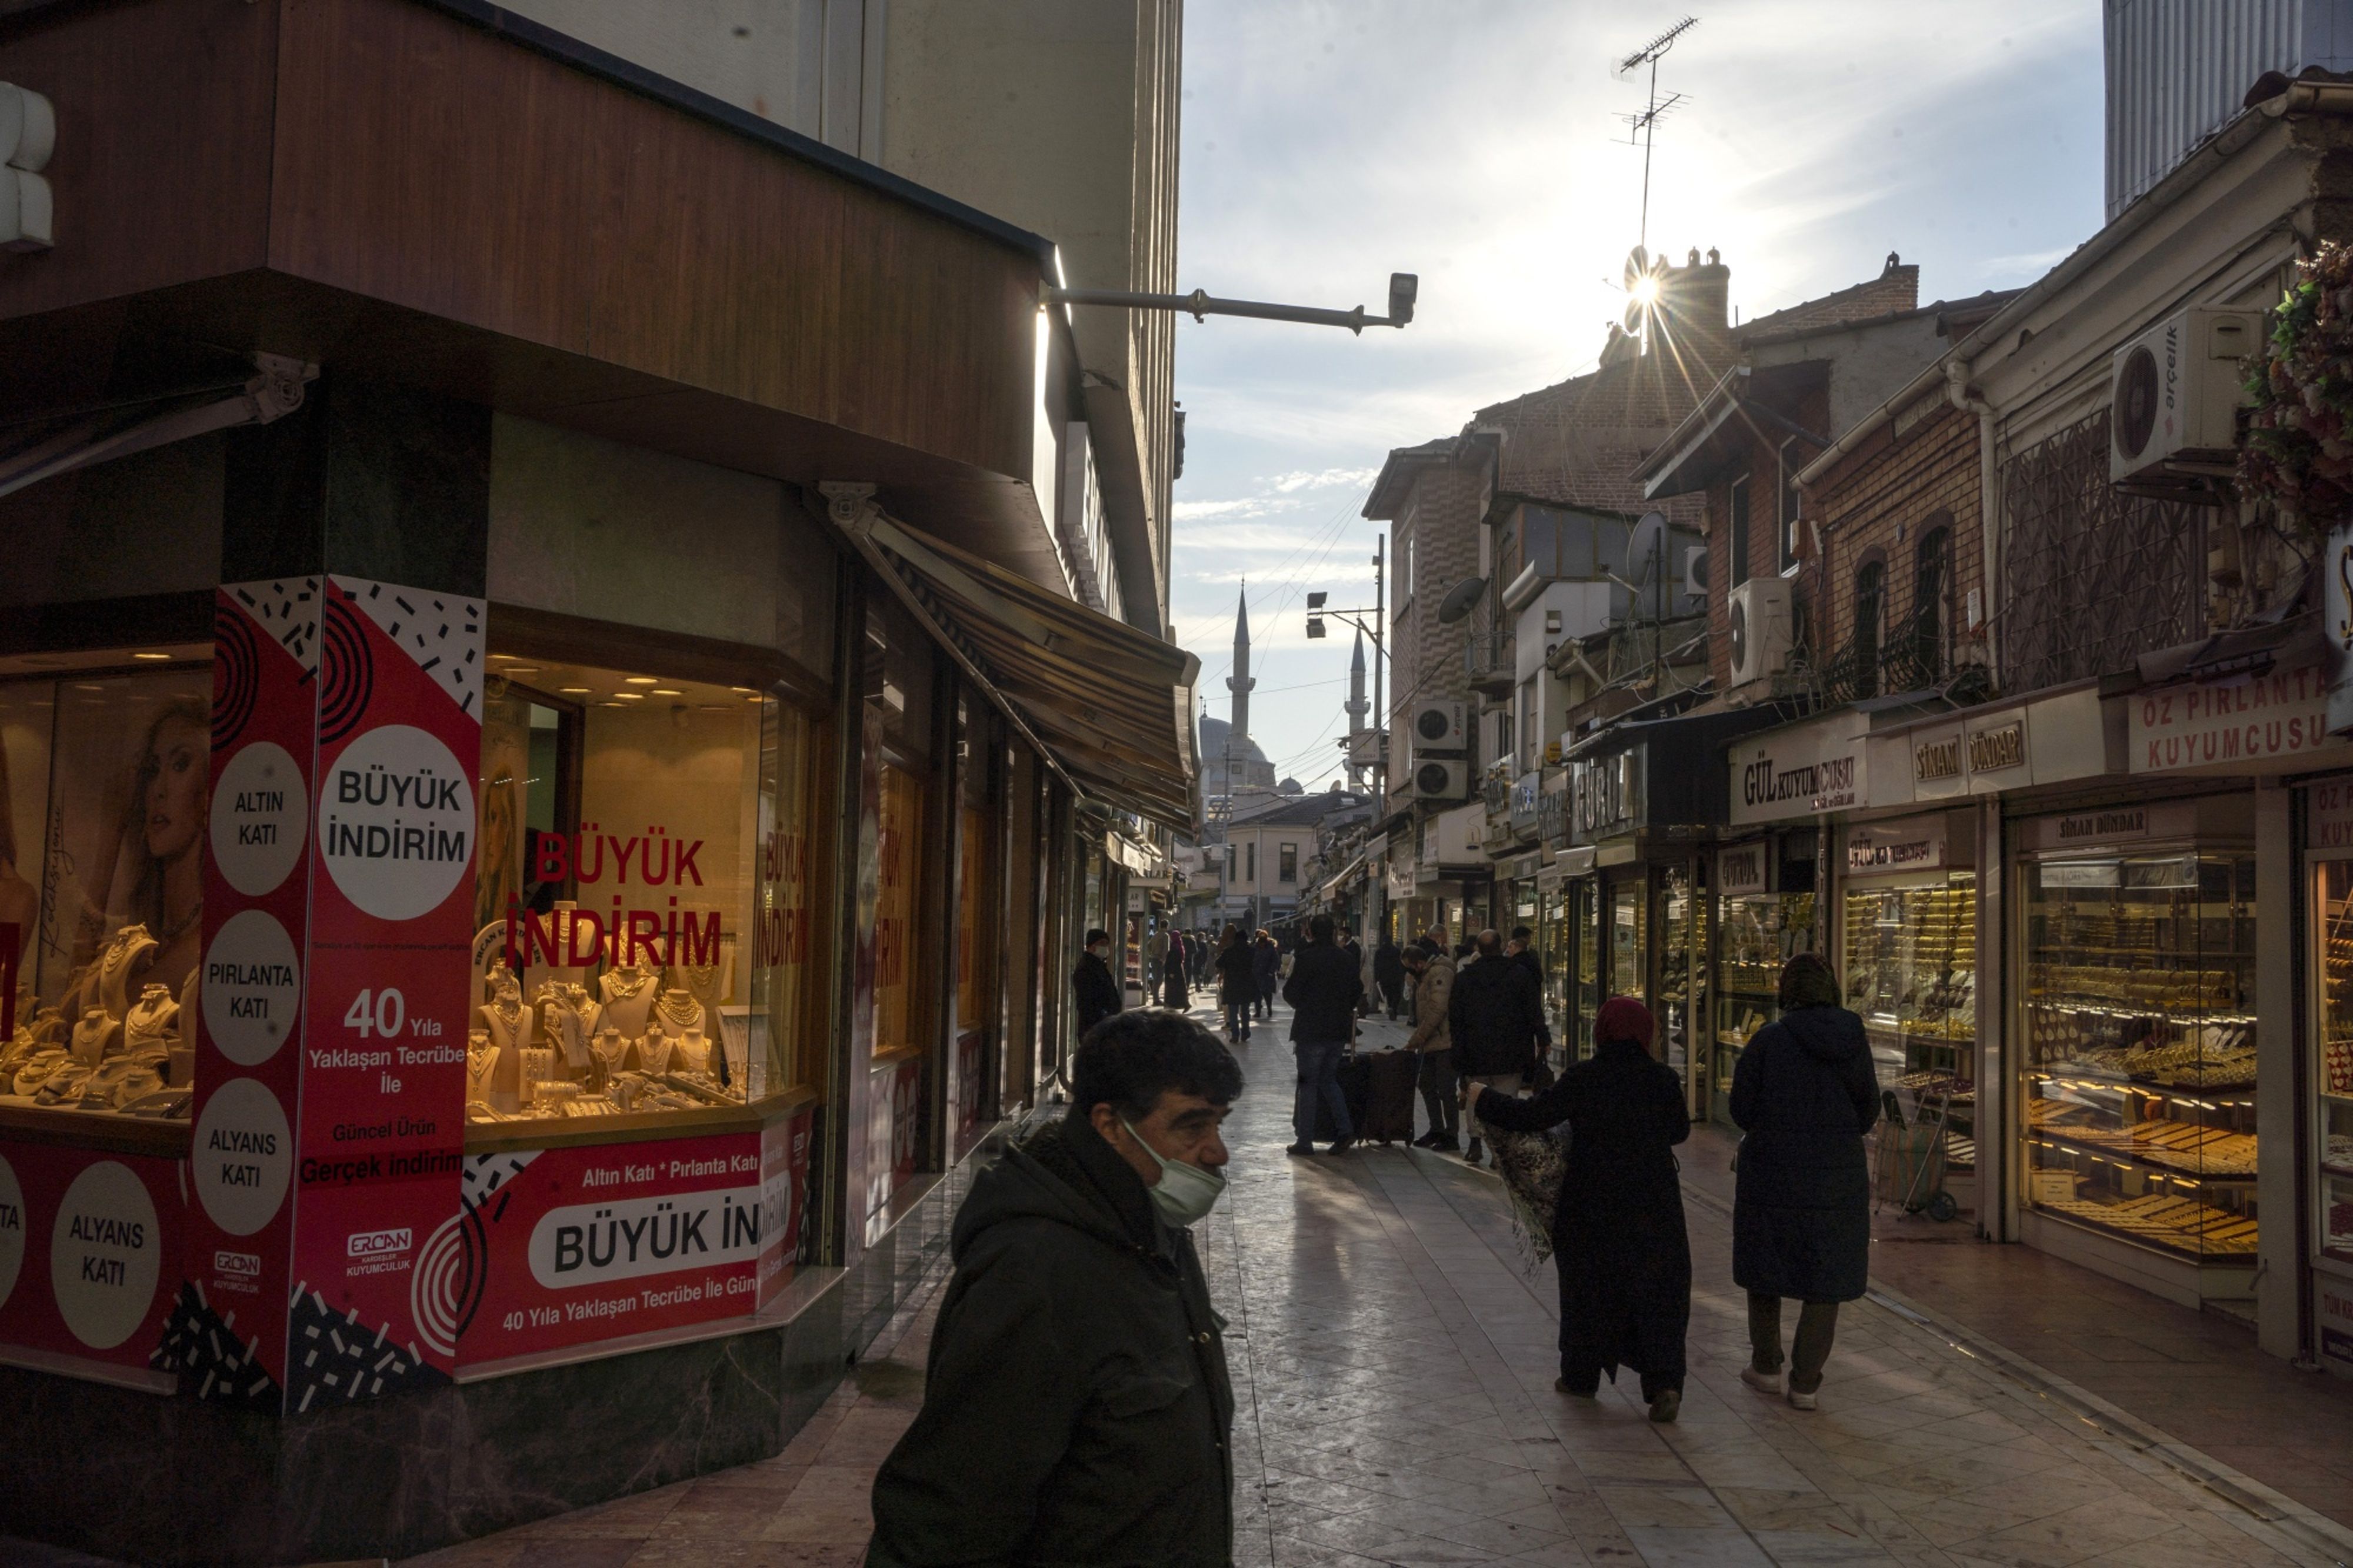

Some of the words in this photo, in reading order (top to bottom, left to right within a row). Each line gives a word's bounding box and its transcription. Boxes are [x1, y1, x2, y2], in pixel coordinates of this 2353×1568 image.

[2165, 325, 2178, 411] arçelik
[1918, 742, 1958, 778] SİNAN
[1968, 730, 2019, 772] DÜNDAR
[2149, 714, 2326, 768] KUYUMCUSU
[338, 765, 461, 811] BÜYÜK
[1744, 749, 1777, 806] GÜL
[1778, 756, 1854, 800] KUYUMCUSU
[235, 792, 284, 813] ALTIN
[239, 824, 276, 845] KATI
[328, 815, 465, 862] İNDİRİM
[2059, 817, 2092, 838] SİNAN
[2097, 812, 2143, 835] DÜNDAR
[535, 822, 704, 887] BÜYÜK
[766, 821, 805, 883] BÜYÜK
[505, 892, 721, 968] İNDİRİM
[475, 932, 496, 965] ERCAN
[209, 963, 294, 987] PIRLANTA
[230, 996, 268, 1019] KATI
[344, 987, 404, 1039] 40
[411, 1019, 442, 1037] Yıla
[309, 1048, 391, 1072] Yaklaşan
[398, 1046, 465, 1065] Tecrübe
[381, 1072, 402, 1094] İle
[209, 1130, 276, 1156] ALYANS
[333, 1120, 391, 1142] Güncel
[396, 1116, 436, 1137] Ürün
[221, 1163, 261, 1187] KATI
[300, 1157, 381, 1185] Gerçek
[582, 1167, 620, 1187] Altın
[625, 1164, 655, 1182] Katı
[670, 1158, 726, 1179] Pırlanta
[731, 1156, 758, 1174] Katı
[69, 1215, 144, 1249] ALYANS
[352, 1232, 408, 1253] ERCAN
[555, 1202, 707, 1273] BÜYÜK
[82, 1257, 125, 1287] KATI
[217, 1254, 258, 1273] ERCAN
[346, 1260, 410, 1277] KUYUMCULUK
[504, 1312, 524, 1332] 40
[529, 1305, 559, 1329] Yıla
[565, 1296, 636, 1321] Yaklaşan
[641, 1287, 702, 1309] Tecrübe
[705, 1276, 723, 1299] İle
